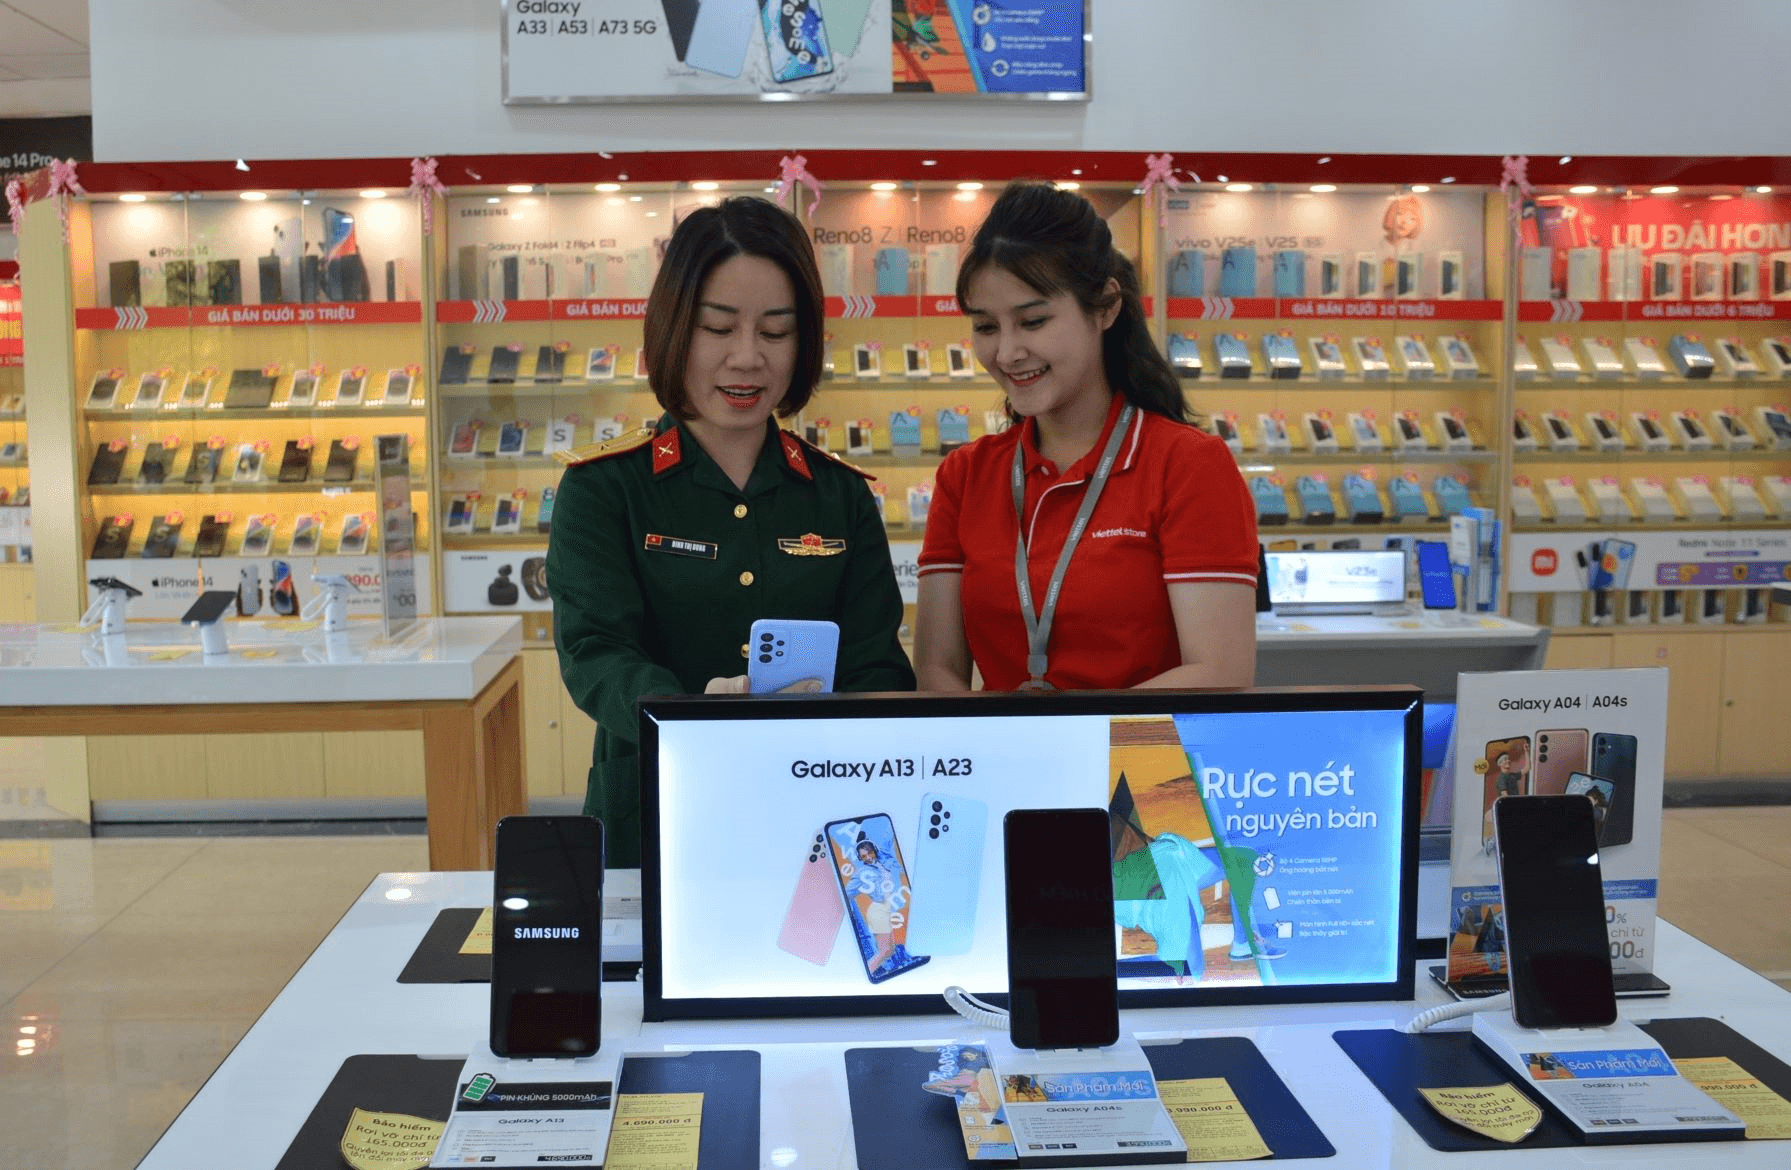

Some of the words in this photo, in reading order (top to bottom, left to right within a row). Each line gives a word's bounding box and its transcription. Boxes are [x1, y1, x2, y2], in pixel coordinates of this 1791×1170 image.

[517, 0, 580, 17] Galaxy
[517, 20, 547, 34] A33
[558, 20, 587, 34] A53
[598, 20, 628, 34] A73
[633, 20, 657, 34] 5G
[461, 207, 509, 218] SAMSUNG
[814, 226, 873, 244] Reno8
[880, 226, 892, 244] Z
[907, 225, 966, 243] Reno8
[1175, 238, 1212, 248] vivo
[1266, 237, 1299, 248] V25
[208, 309, 230, 321] GIÁ
[233, 308, 261, 321] BÁN
[299, 308, 315, 320] 30
[317, 306, 356, 321] TRIỆU
[567, 302, 590, 315] GIÁ
[591, 302, 619, 315] BÁN
[553, 428, 566, 442] S
[161, 576, 199, 587] iPhone
[1498, 698, 1551, 714] Galaxy
[1553, 697, 1582, 709] A04
[1592, 695, 1628, 708] A04s
[791, 759, 876, 783] Galaxy
[879, 759, 915, 777] A13
[932, 758, 973, 777] A23
[1202, 767, 1279, 809] Rực
[1288, 760, 1356, 798] nét
[1226, 807, 1323, 838] nguyên
[1328, 805, 1378, 829] bản
[514, 927, 580, 939] SAMSUNG
[500, 1094, 516, 1102] PIN
[517, 1092, 550, 1102] KHỦNG
[551, 1094, 598, 1102] 5000mAh
[1046, 1105, 1090, 1113] Galaxy
[1093, 1105, 1123, 1113] A04s
[373, 1118, 397, 1129] Bảo
[400, 1122, 431, 1132] hiểm
[498, 1117, 543, 1125] Galaxy
[622, 1118, 680, 1126] 4.690.000
[356, 1125, 378, 1136] Rơi
[382, 1131, 400, 1139] vỡ
